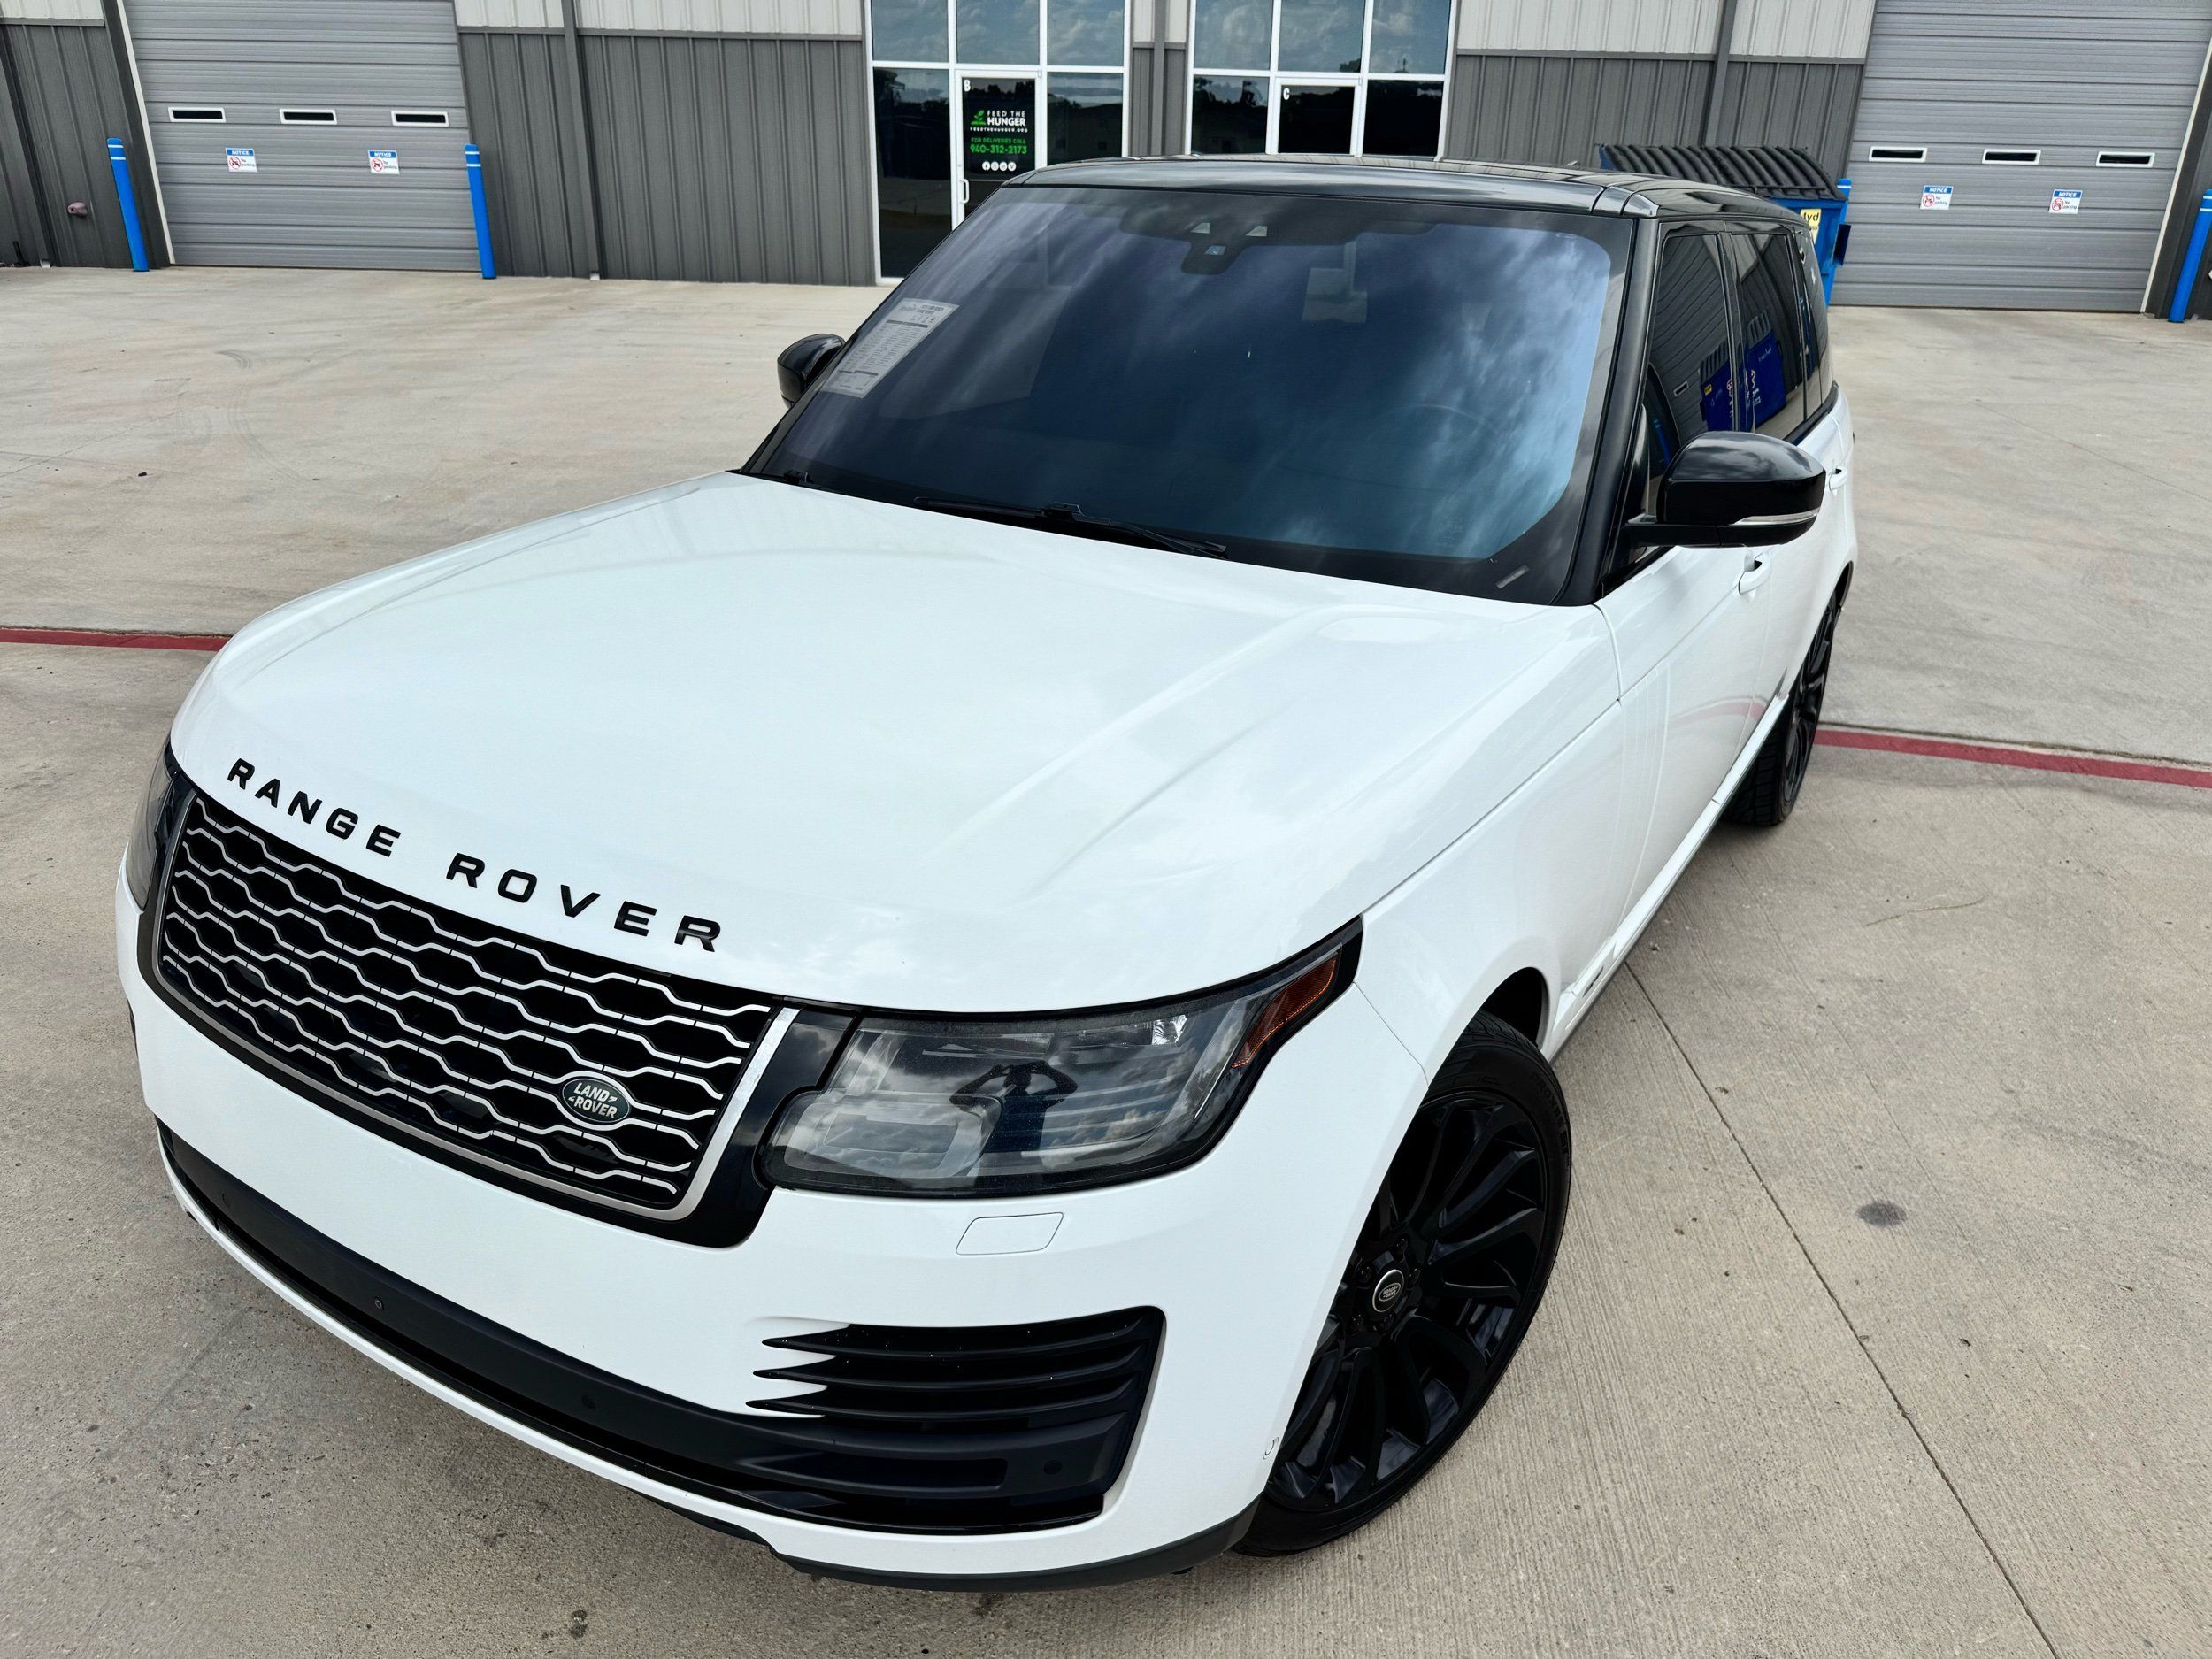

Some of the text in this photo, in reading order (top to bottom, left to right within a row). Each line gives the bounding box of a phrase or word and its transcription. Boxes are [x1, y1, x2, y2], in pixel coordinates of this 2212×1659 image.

[964, 80, 971, 92] B
[1283, 88, 1290, 101] C
[987, 117, 1026, 127] HUNGER
[970, 144, 1028, 155] 940-312-2173
[227, 758, 722, 953] RANGE ROVER
[573, 1082, 611, 1102] LAND
[573, 1096, 618, 1118] ROVER
